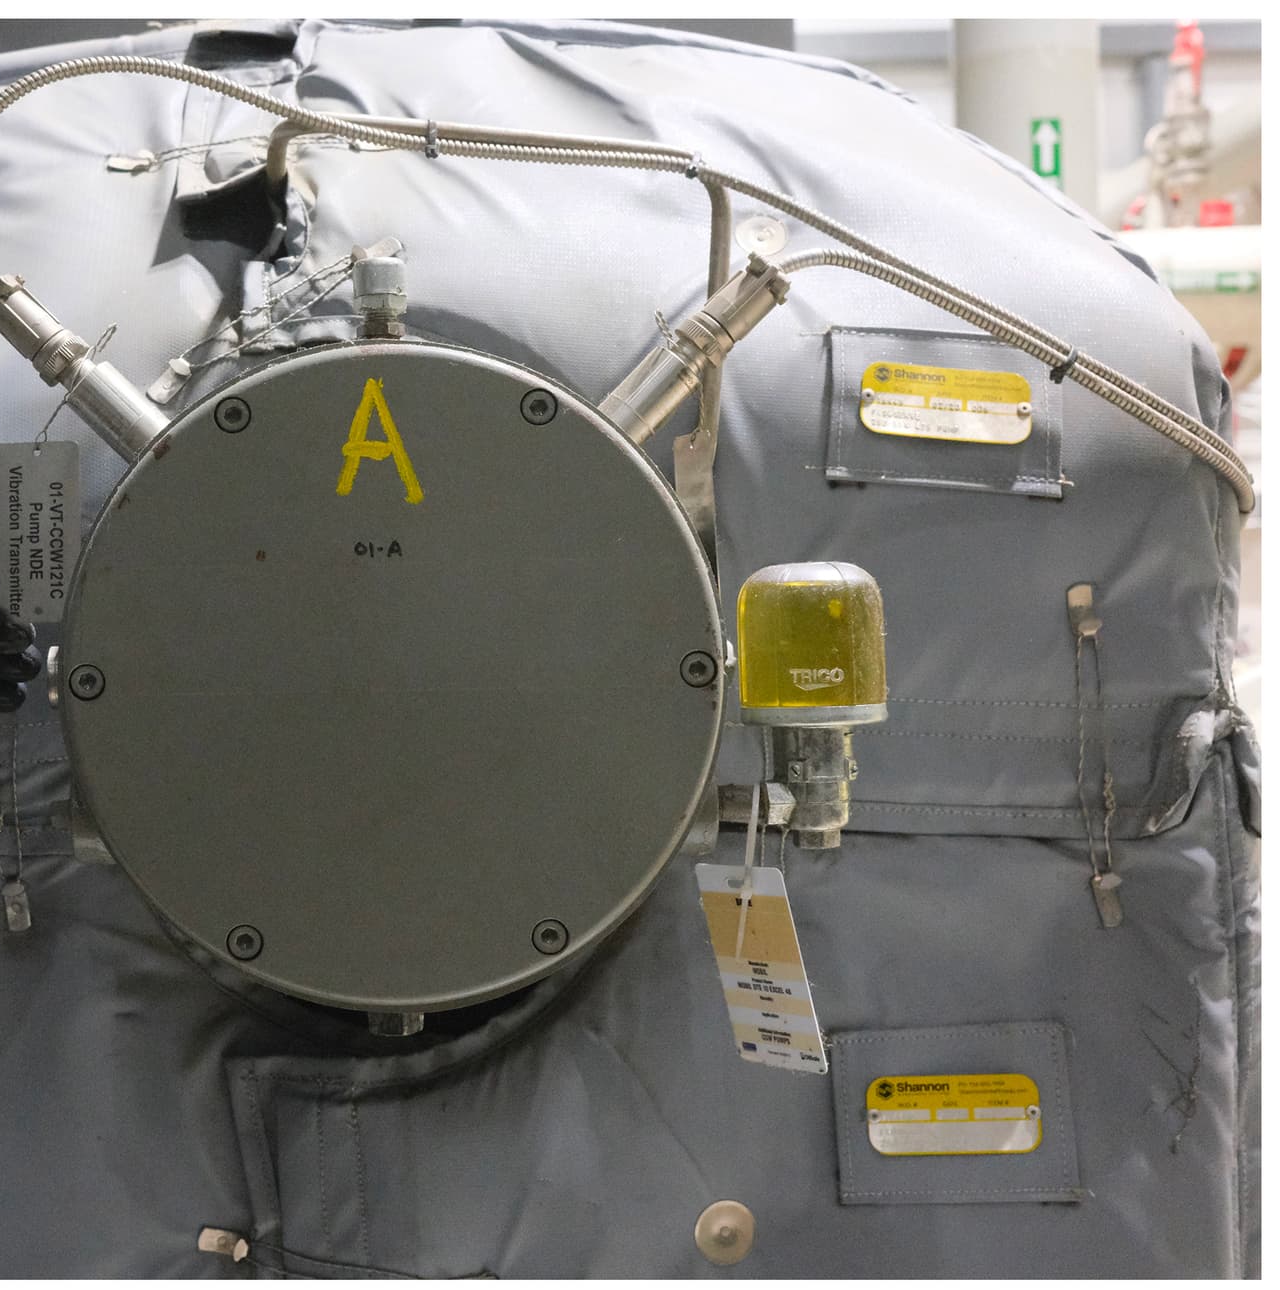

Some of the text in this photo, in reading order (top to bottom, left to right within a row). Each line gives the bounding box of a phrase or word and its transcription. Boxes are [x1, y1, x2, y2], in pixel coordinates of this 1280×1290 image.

[893, 369, 946, 383] Shannon
[336, 377, 424, 504] A
[9, 465, 24, 618] Vibration Transmitter
[27, 502, 44, 580] Pump NDE
[49, 481, 64, 600] 01-VT-CCW121C
[790, 668, 844, 685] TRICO
[896, 1081, 949, 1093] Shannon
